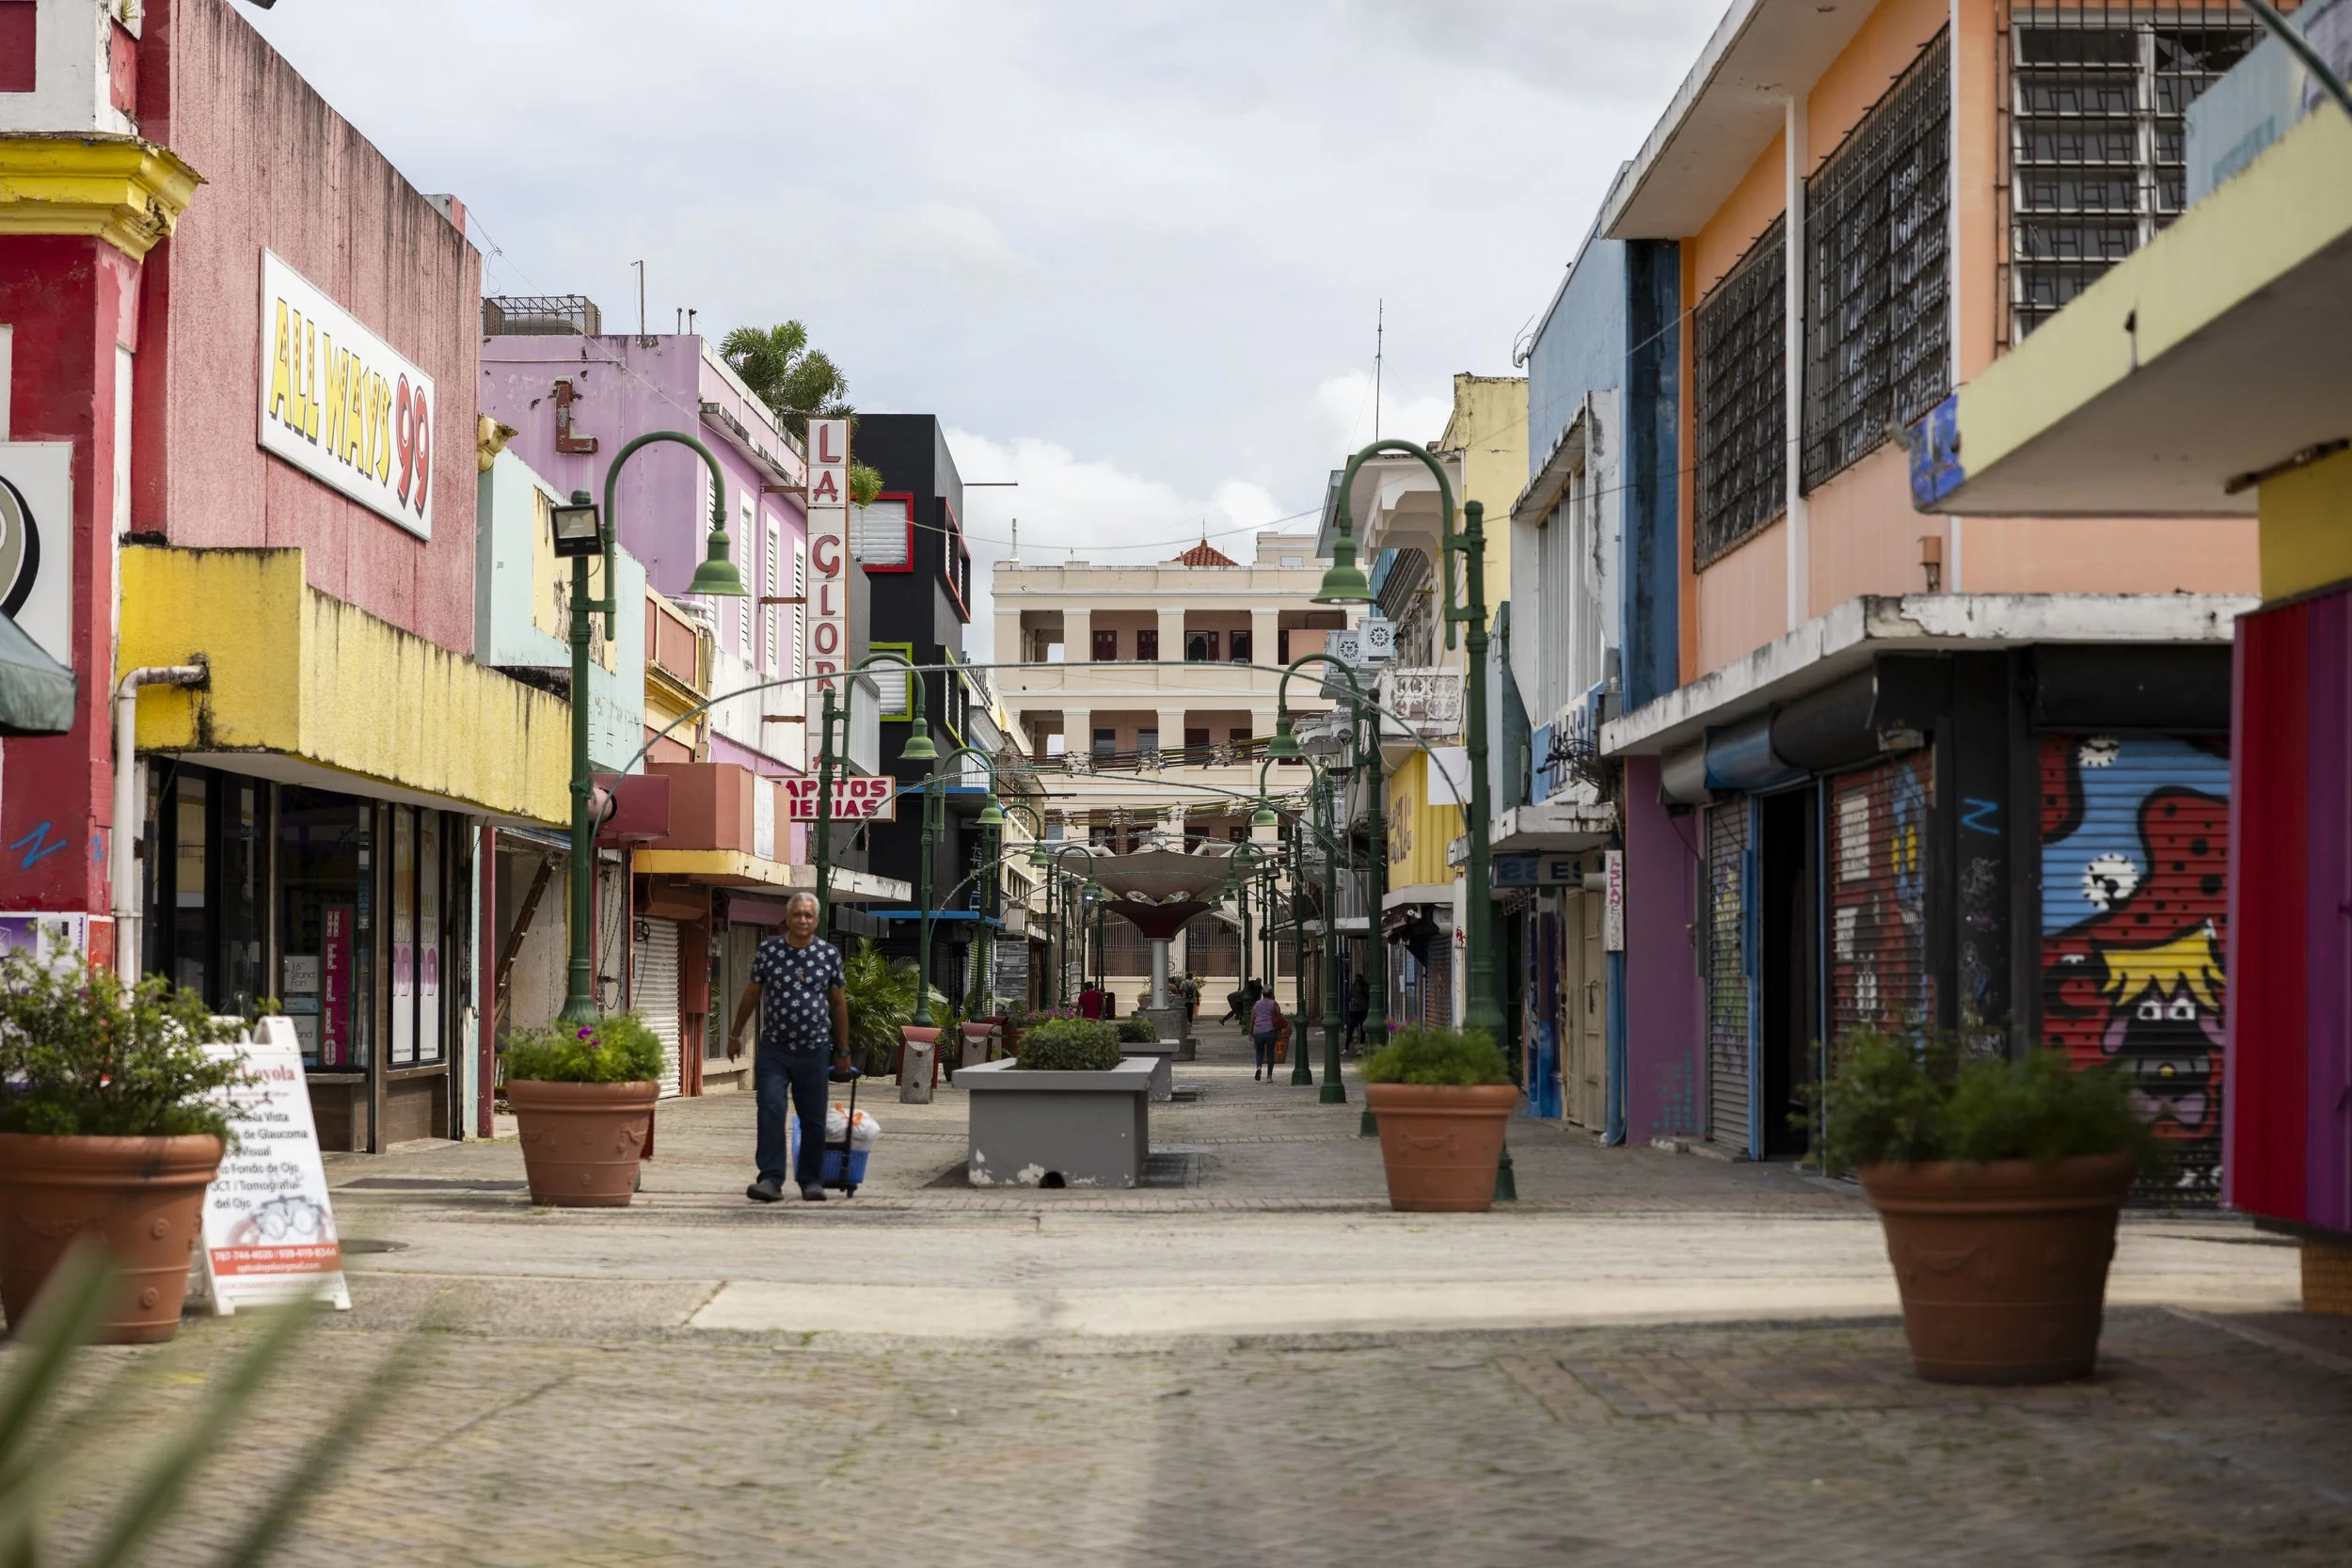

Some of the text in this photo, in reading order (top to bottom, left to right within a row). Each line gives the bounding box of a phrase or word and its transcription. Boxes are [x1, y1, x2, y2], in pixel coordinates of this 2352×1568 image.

[395, 372, 430, 520] 99
[811, 422, 842, 770] LA GLOR
[772, 780, 887, 798] APTOS
[790, 800, 879, 817] EIAS
[290, 970, 316, 980] Stand
[290, 978, 308, 988] Fan
[324, 911, 341, 1067] HELLO
[294, 1031, 313, 1039] and
[264, 1111, 291, 1123] Vista
[242, 1128, 310, 1139] de Glaucoma
[240, 1145, 272, 1156] Visual
[230, 1163, 264, 1174] Fondo
[266, 1163, 279, 1174] de
[280, 1162, 300, 1176] Ojo
[211, 1181, 231, 1192] OCT
[215, 1197, 252, 1212] del Ojo
